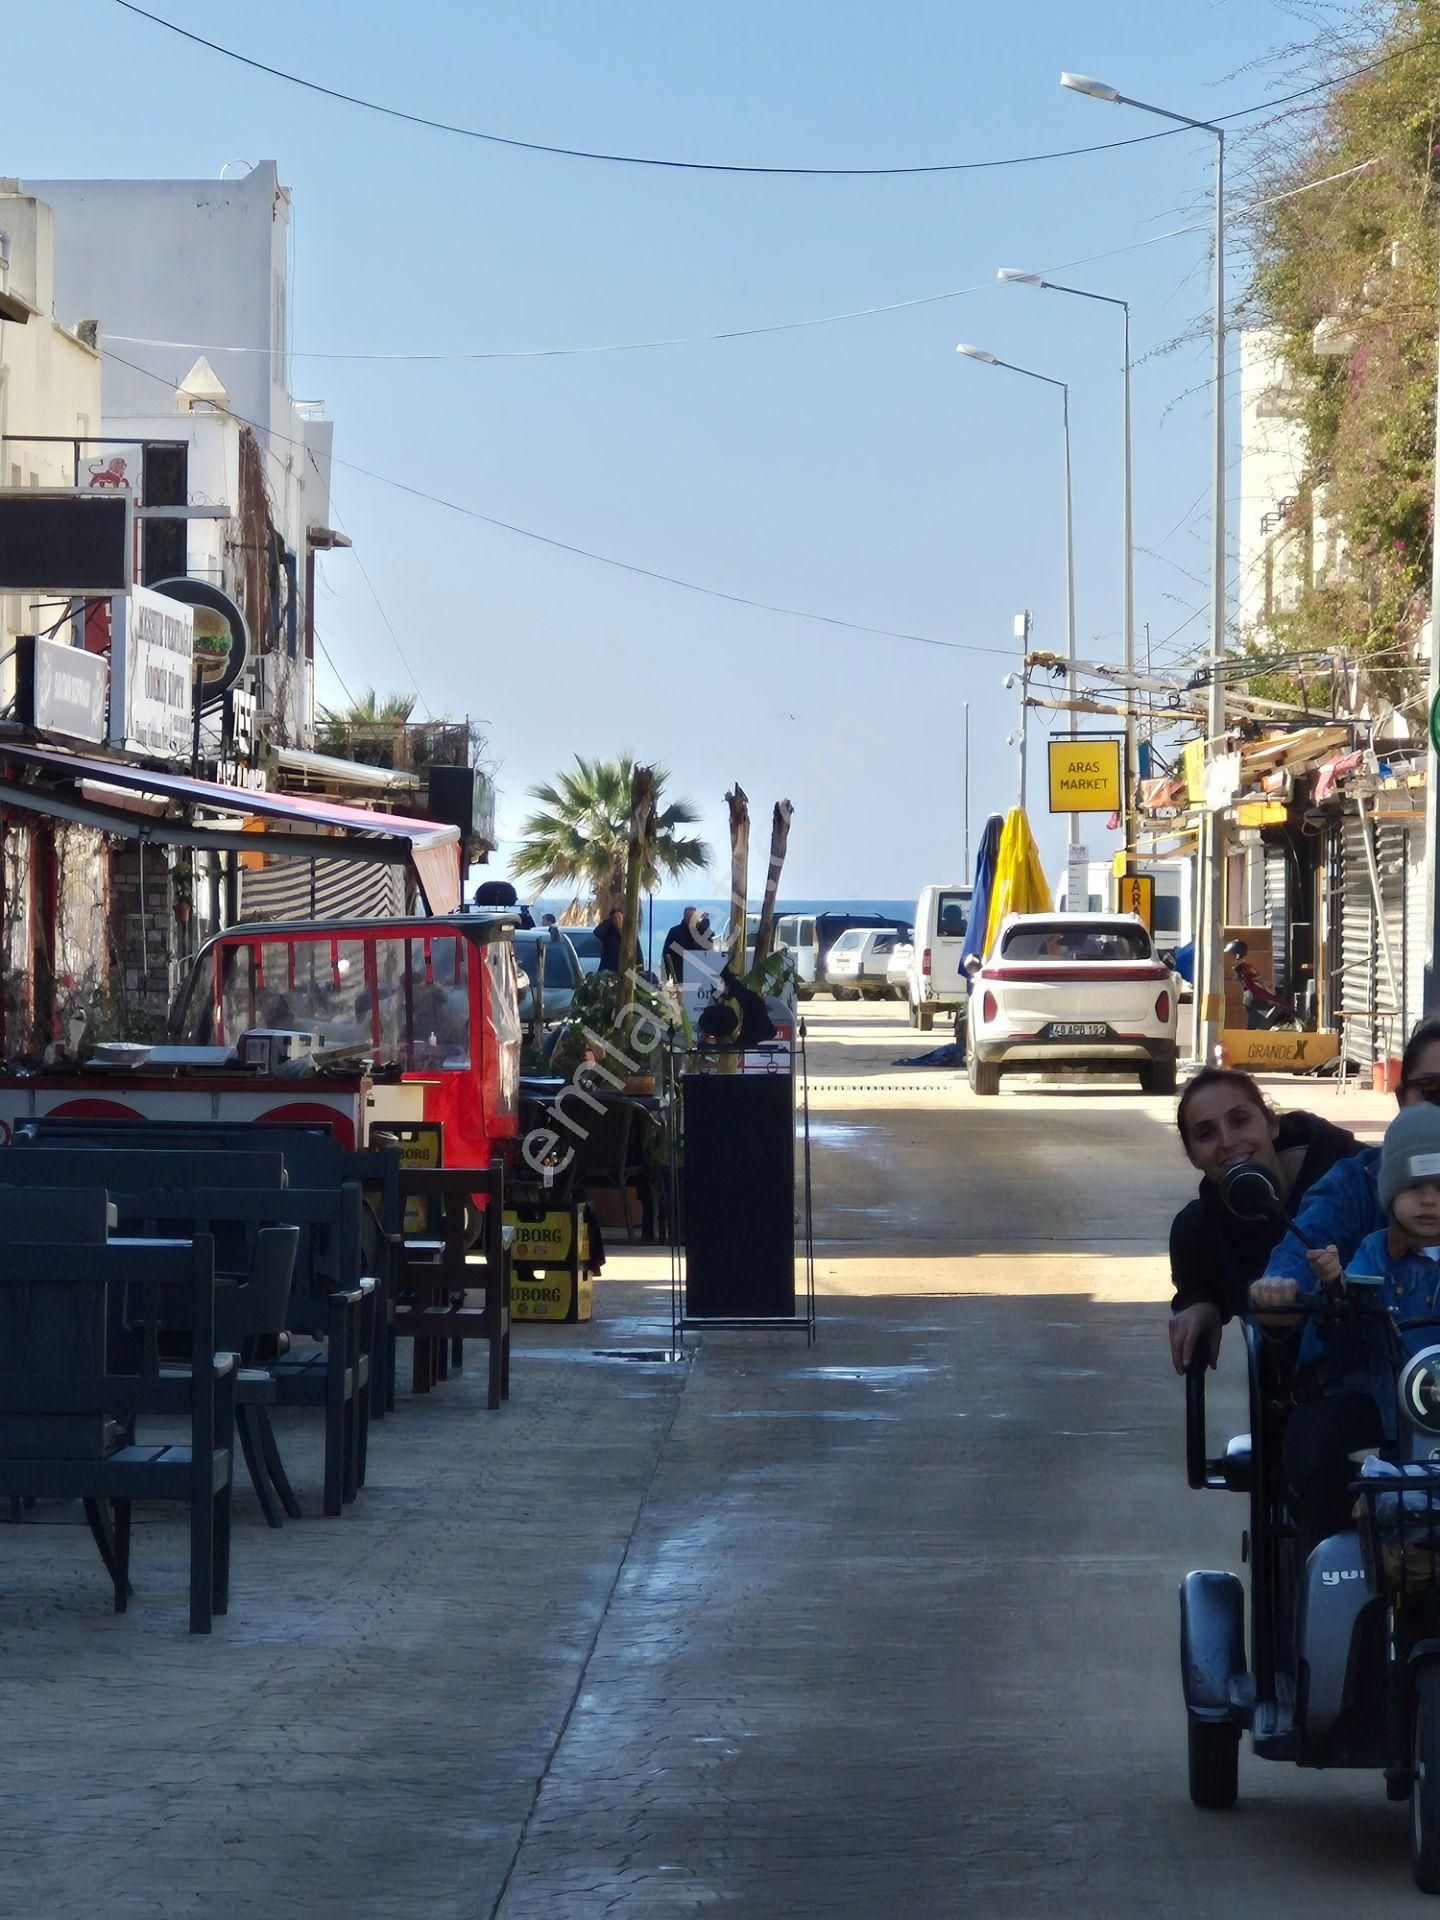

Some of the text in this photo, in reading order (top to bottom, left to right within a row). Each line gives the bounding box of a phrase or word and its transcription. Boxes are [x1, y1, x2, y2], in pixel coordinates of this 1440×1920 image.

[1068, 762, 1100, 773] ARAS
[1060, 778, 1109, 790] MARKET
[1131, 878, 1142, 915] ARA
